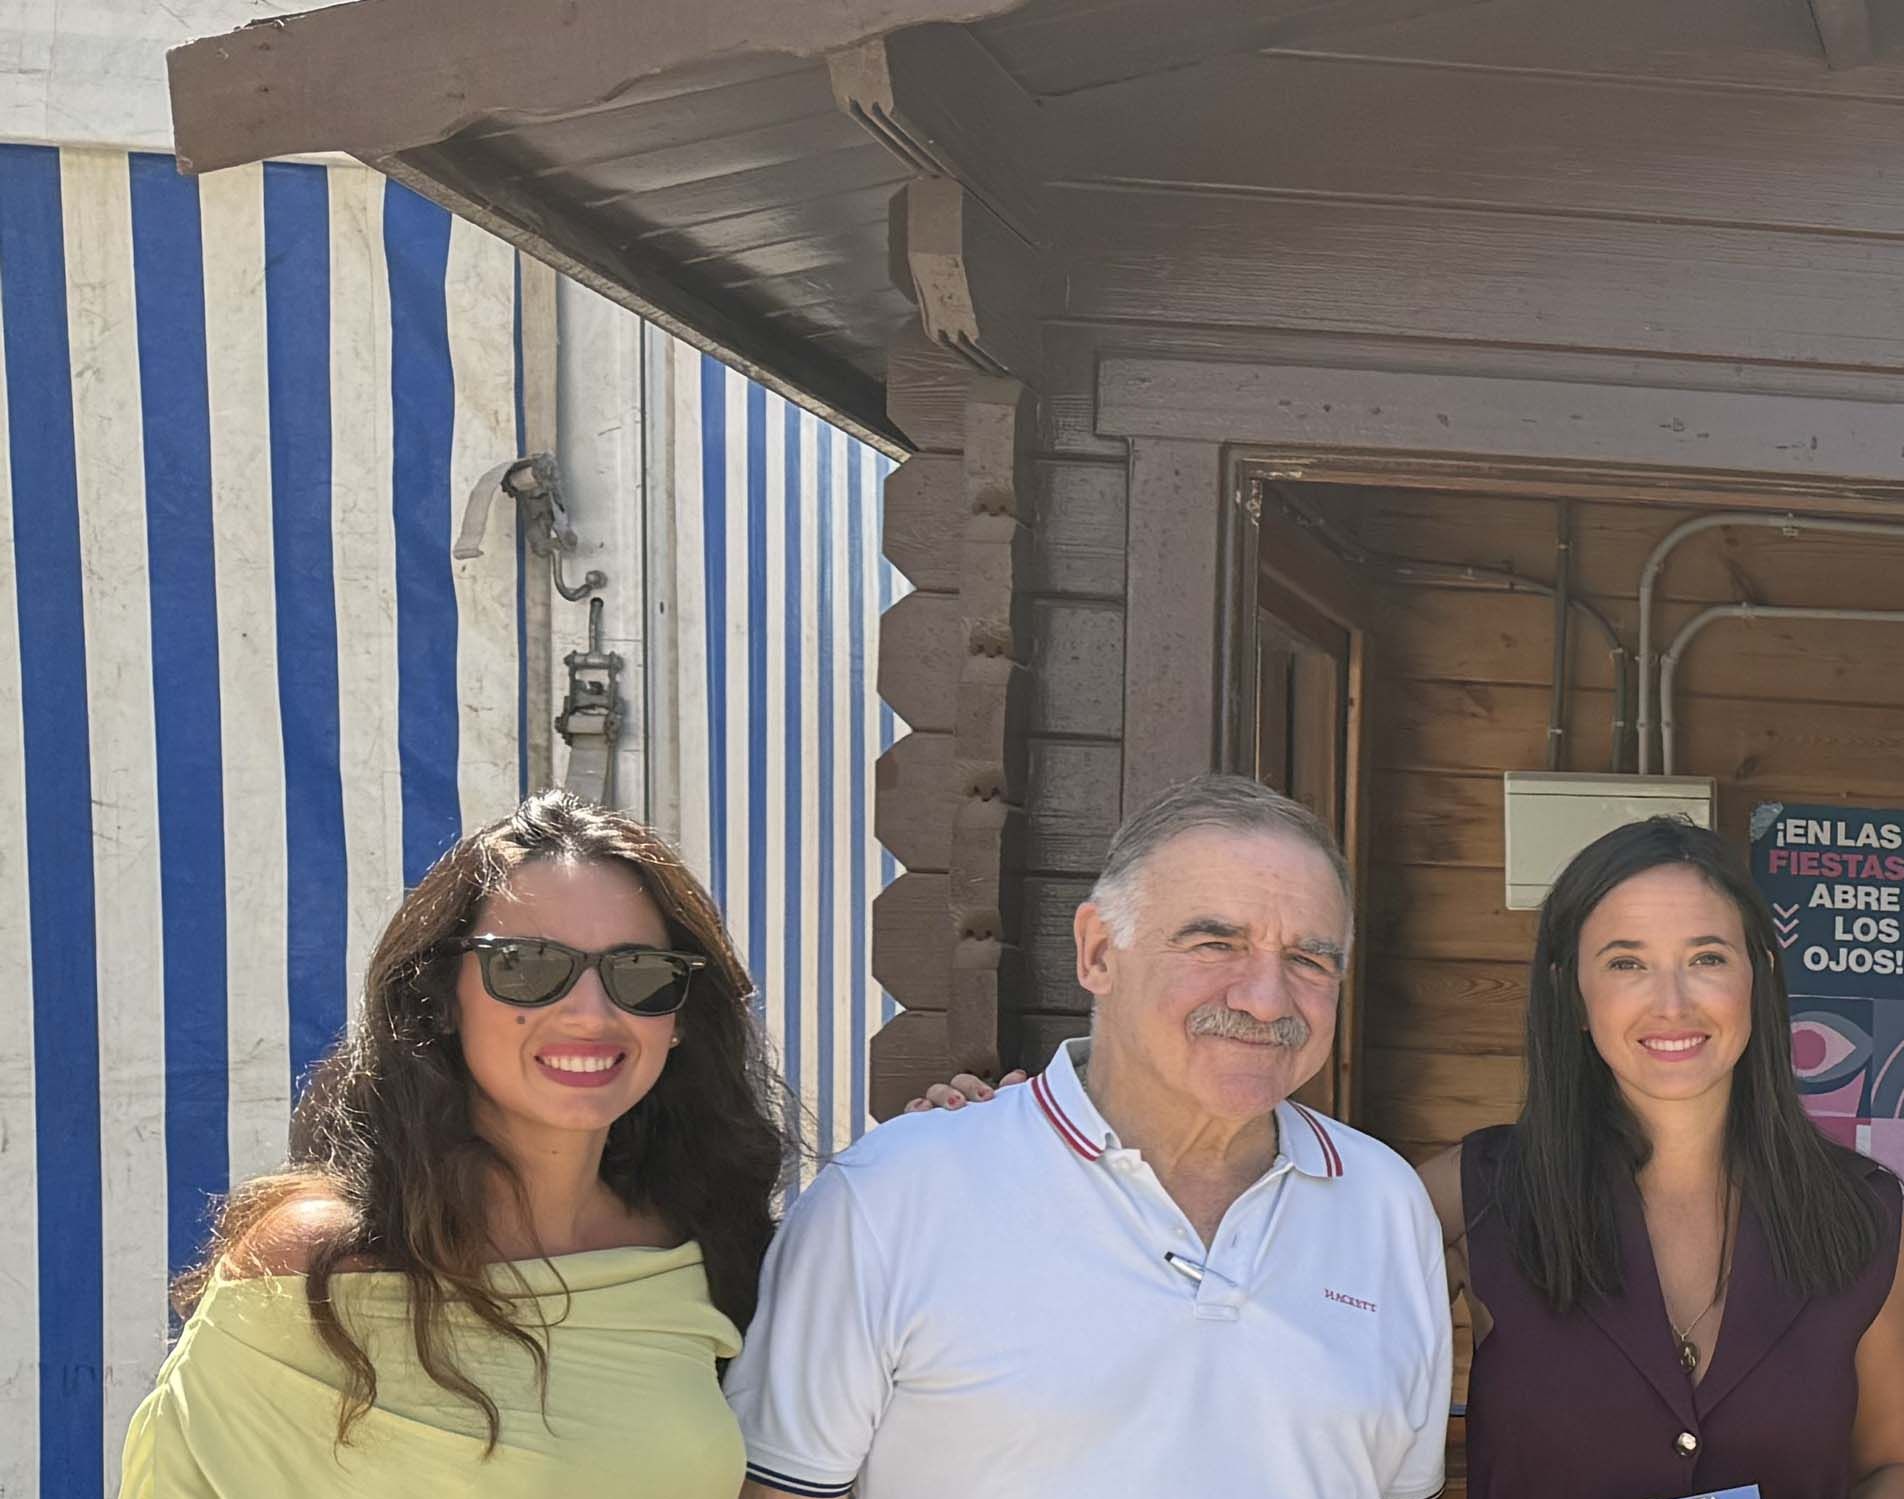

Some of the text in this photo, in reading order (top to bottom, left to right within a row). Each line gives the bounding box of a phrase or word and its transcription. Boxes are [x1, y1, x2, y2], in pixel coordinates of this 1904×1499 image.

[1776, 818, 1903, 849] ¡EN LAS
[1808, 883, 1900, 912] ABRE
[1834, 916, 1900, 943] LOS
[1803, 945, 1904, 975] OJOS!
